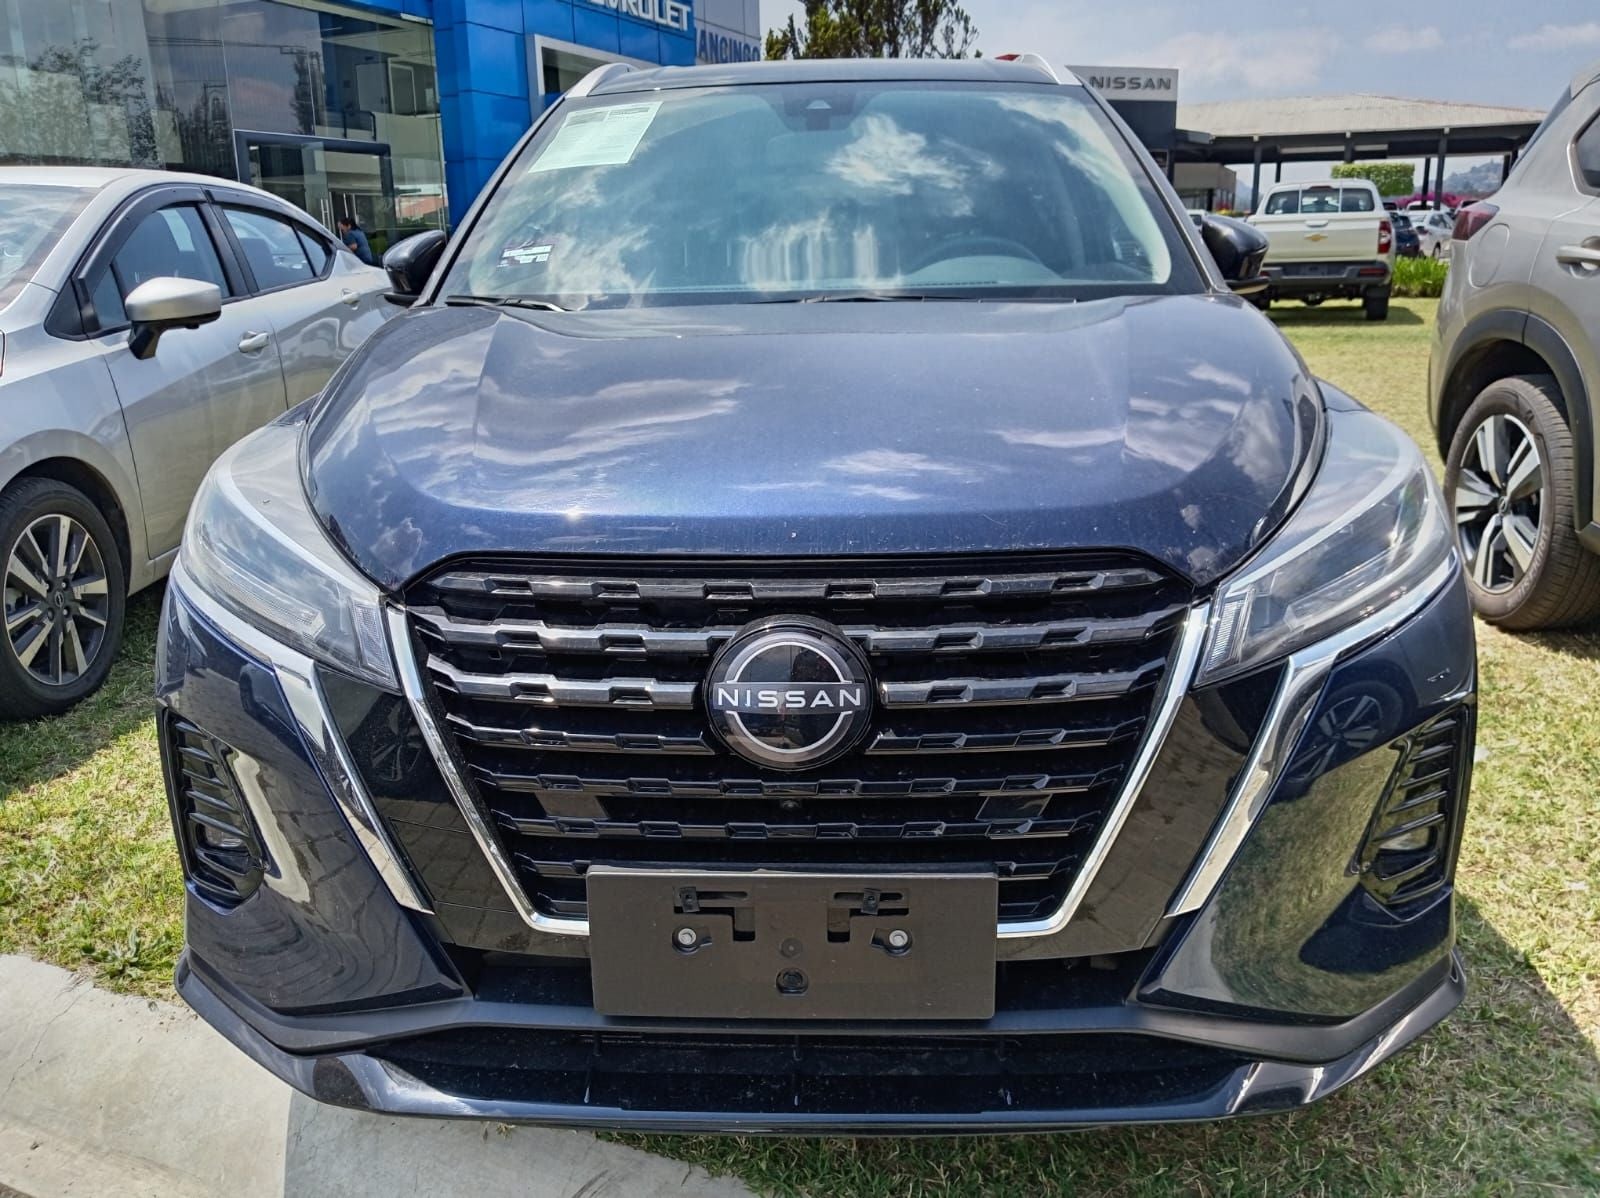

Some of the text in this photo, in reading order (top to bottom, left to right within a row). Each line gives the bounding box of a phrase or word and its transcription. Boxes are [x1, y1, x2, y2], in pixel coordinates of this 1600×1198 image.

[587, 0, 691, 31] ROLET
[1089, 76, 1172, 90] NISSAN
[717, 688, 861, 708] NISSAN
